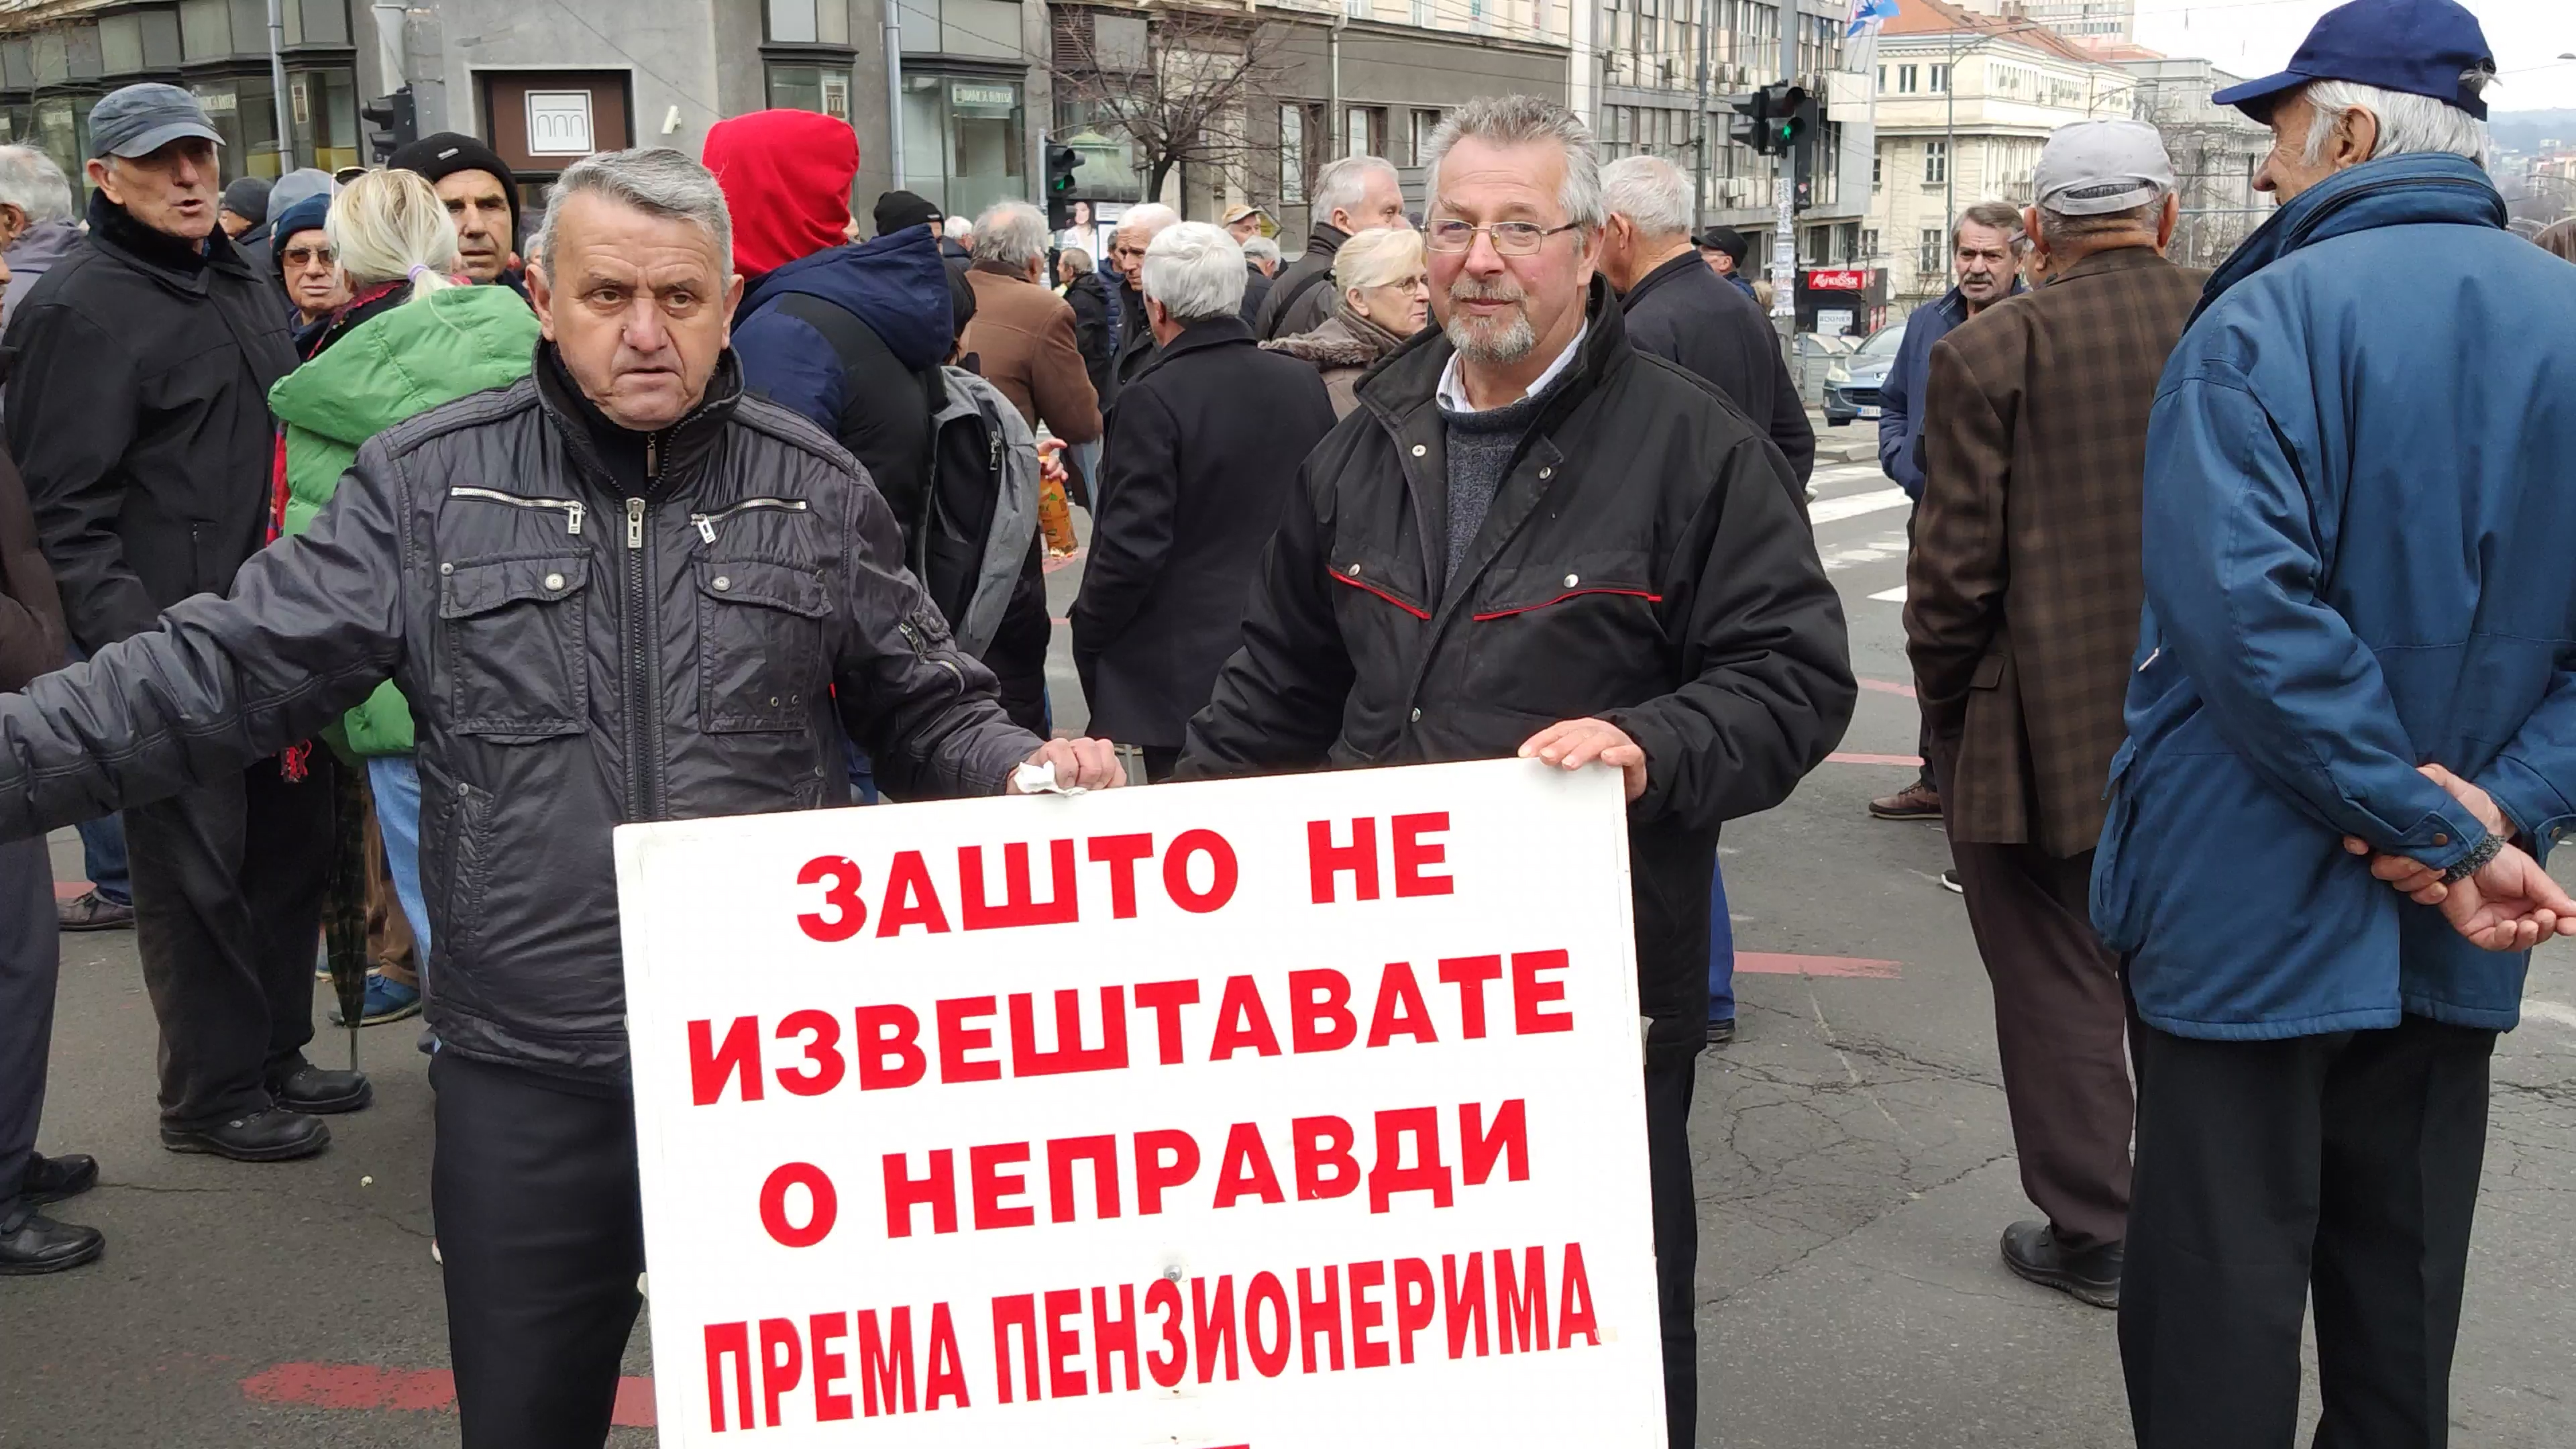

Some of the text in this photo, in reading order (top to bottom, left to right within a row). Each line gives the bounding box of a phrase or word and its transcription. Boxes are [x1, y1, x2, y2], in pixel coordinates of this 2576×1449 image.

[796, 812, 1454, 943] ЗАШТО НЕ
[688, 949, 1573, 1106] ИЗВЕШТАВАТЕ
[759, 1099, 1529, 1248] О НЕПРАВДИ
[704, 1242, 1601, 1433] ПРЕМА ПЕНЗИОНЕРИМА
